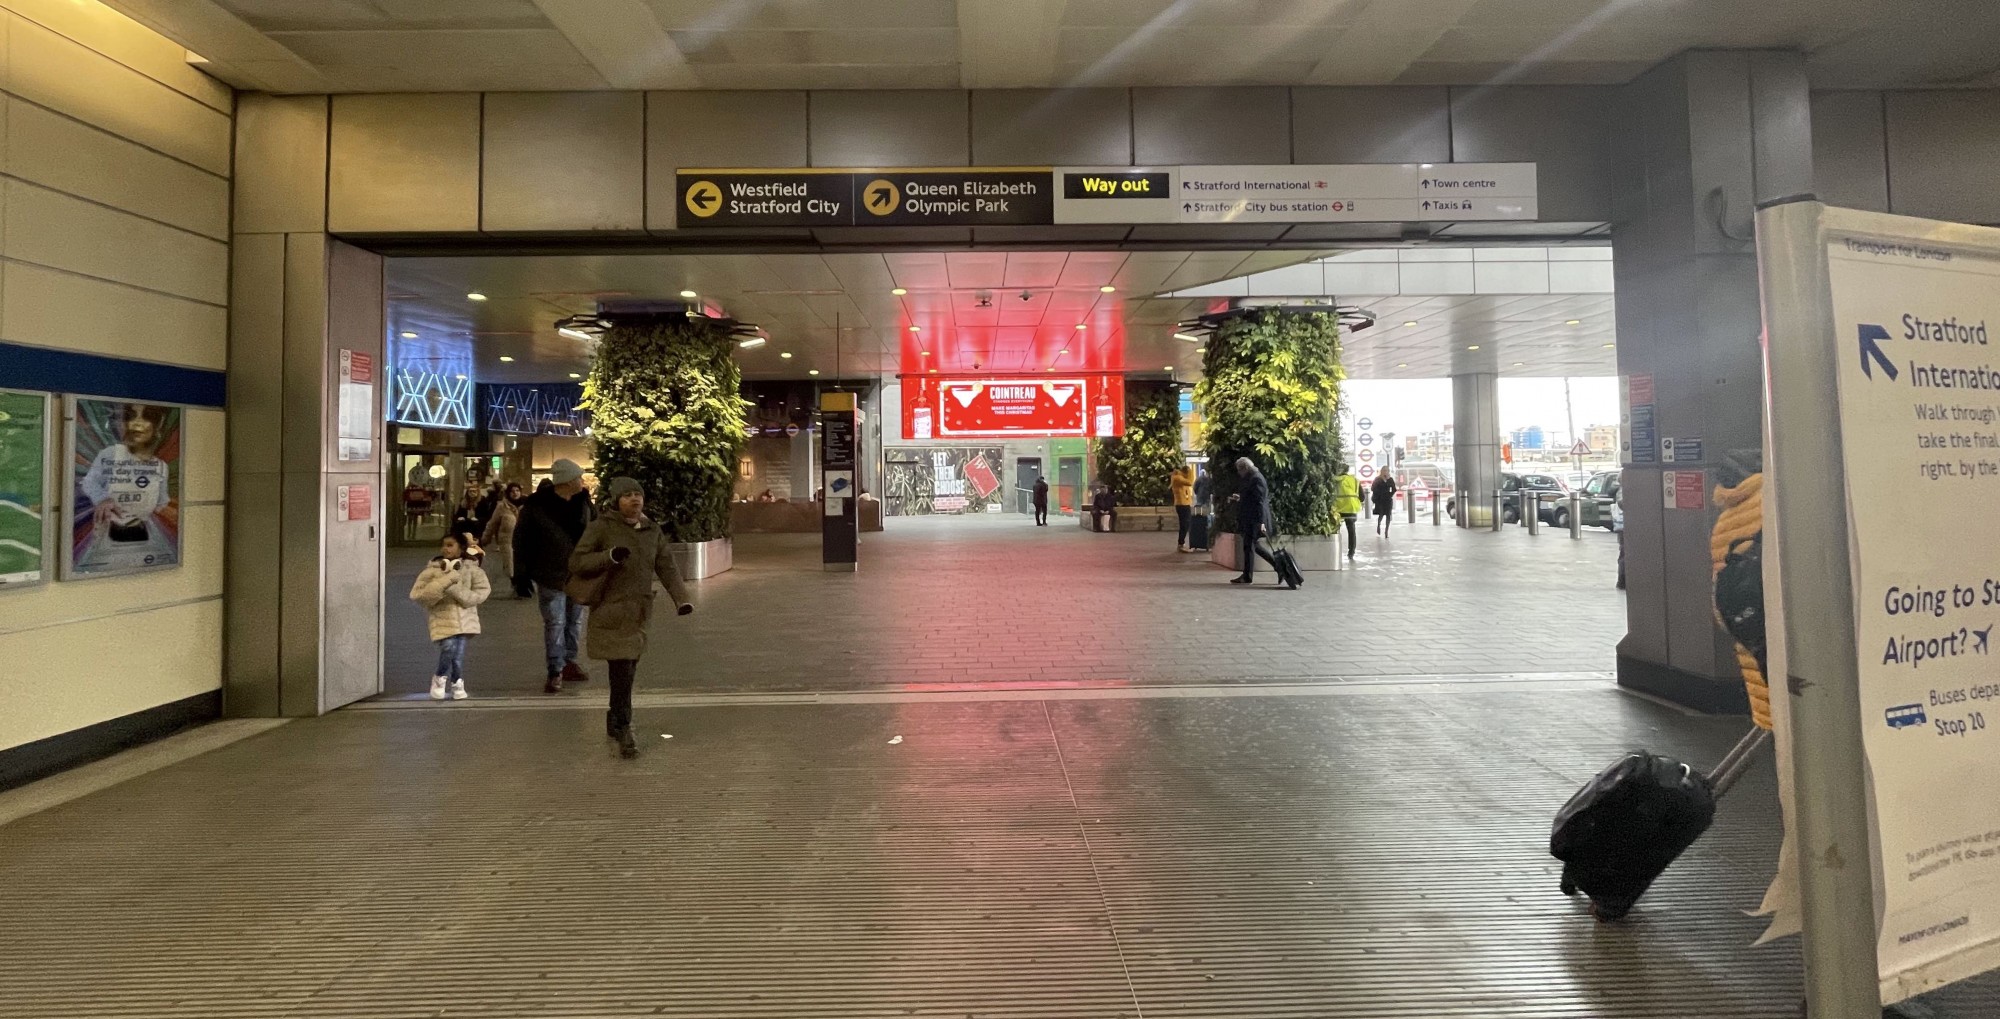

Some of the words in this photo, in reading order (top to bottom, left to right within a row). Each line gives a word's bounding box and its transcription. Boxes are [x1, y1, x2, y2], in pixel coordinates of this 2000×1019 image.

[729, 182, 807, 197] Westfield
[905, 181, 958, 196] Queen
[963, 181, 1037, 195] Elizabeth
[1082, 177, 1117, 195] Way
[1121, 178, 1150, 192] out
[1193, 180, 1240, 190] Stratford
[1244, 180, 1311, 190] International
[1432, 179, 1459, 188] Town
[1462, 180, 1496, 188] centre
[729, 200, 801, 214] Stratford
[806, 200, 840, 216] City
[905, 199, 970, 216] Olympic
[975, 199, 1009, 212] Park
[1245, 202, 1266, 214] City
[1269, 202, 1288, 212] bus
[1291, 201, 1329, 212] station
[1433, 200, 1458, 210] Taxis
[1844, 237, 1898, 256] Transport
[1897, 244, 1913, 257] for
[1913, 246, 1953, 262] London
[1902, 313, 1987, 346] Stratford
[989, 386, 1037, 400] COINTREAU
[1914, 403, 1949, 421] Walk
[1951, 406, 1997, 425] through
[1917, 433, 1948, 449] take
[1950, 433, 1972, 449] the
[101, 458, 116, 466] For
[116, 459, 159, 467] unlimited
[933, 451, 948, 467] LET
[102, 467, 114, 476] all
[116, 468, 132, 476] day
[935, 466, 955, 481] THEM
[1958, 459, 1976, 480] by
[1977, 459, 1999, 476] the
[109, 477, 132, 485] think
[934, 479, 966, 496] CHOOSE
[1885, 584, 1946, 617] Going
[1953, 584, 1975, 608] to
[1883, 627, 1967, 669] Airport?
[1929, 688, 1967, 707] Buses
[1934, 713, 1967, 738] Stop
[1968, 711, 1985, 731] 20
